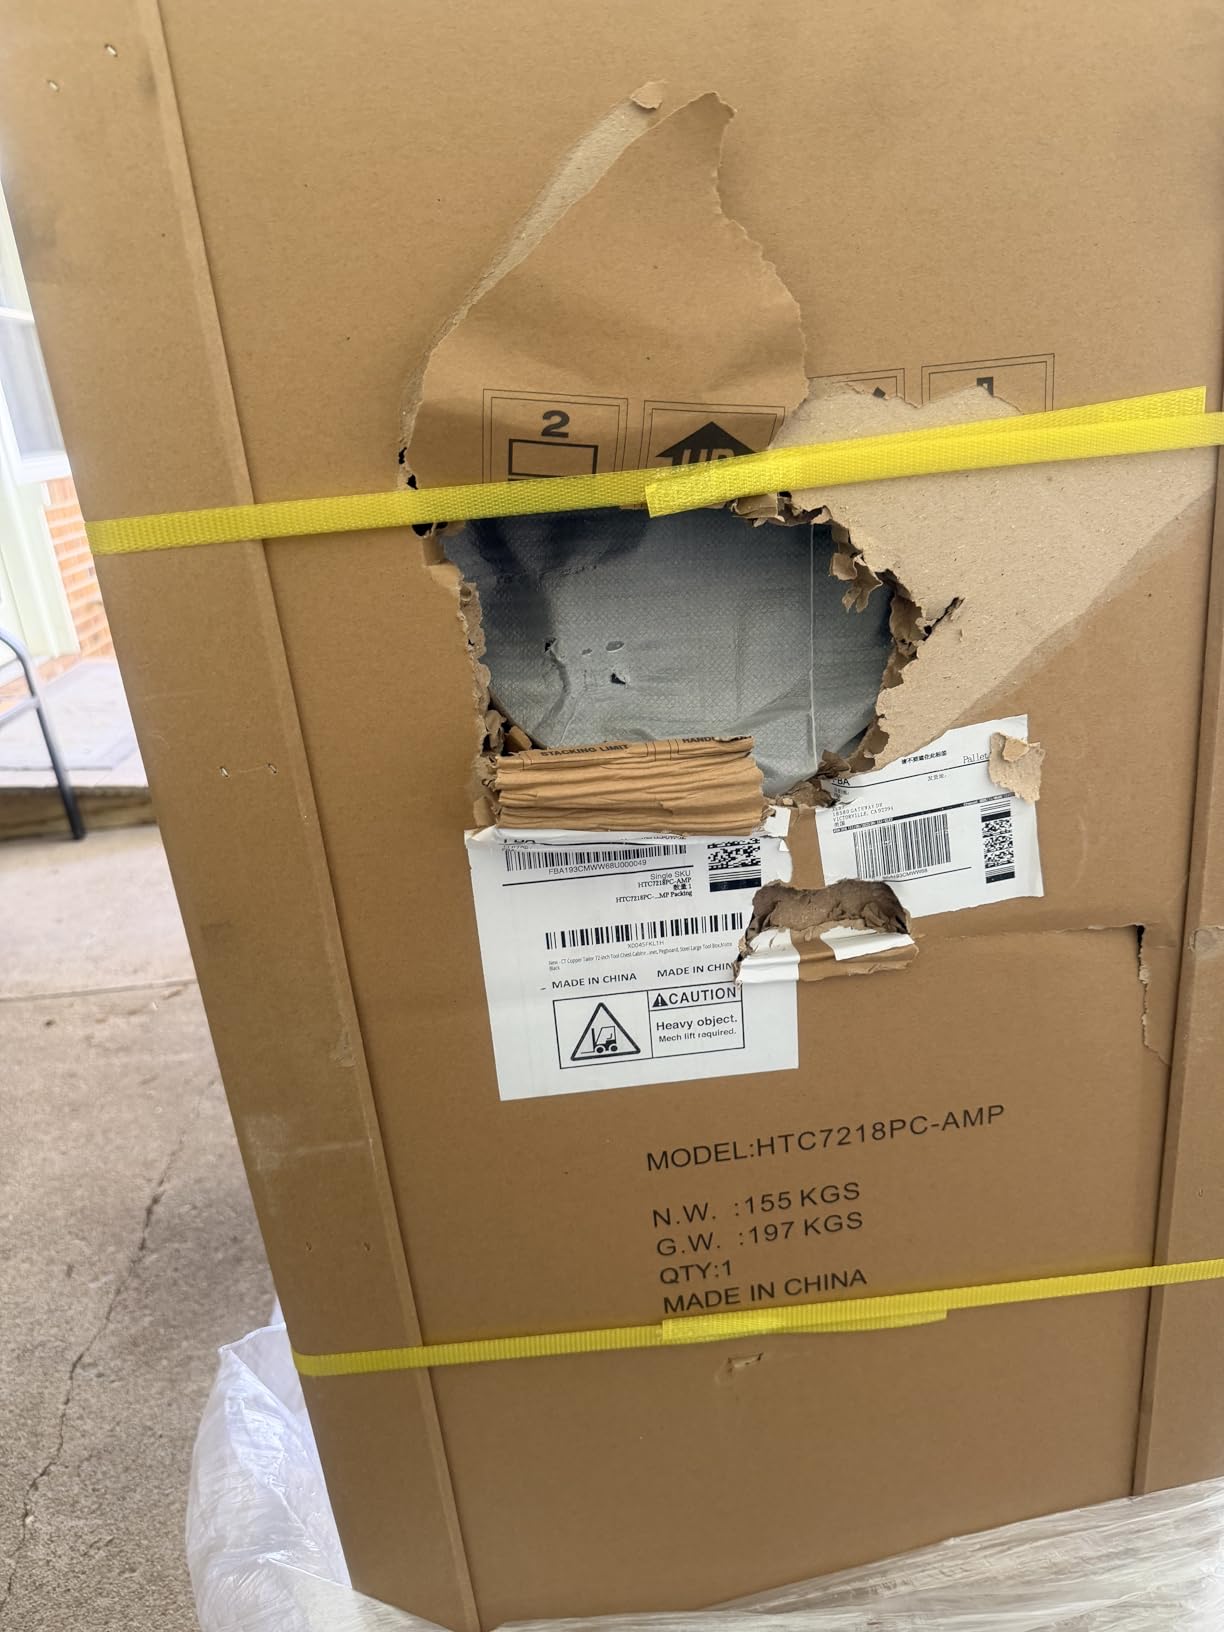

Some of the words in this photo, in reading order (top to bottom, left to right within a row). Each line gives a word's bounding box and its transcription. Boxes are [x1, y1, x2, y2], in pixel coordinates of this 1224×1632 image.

[540, 409, 571, 439] 2
[540, 747, 597, 757] STACKING
[599, 744, 629, 752] LIMIT
[637, 876, 692, 888] HTC7218PC-AMP
[650, 872, 673, 881] Single
[674, 869, 691, 878] SKU
[670, 890, 693, 898] Packing
[656, 966, 690, 978] MADE
[692, 965, 704, 974] IN
[707, 962, 734, 972] CHIN
[551, 977, 585, 989] MADE
[588, 976, 600, 985] IN
[602, 972, 638, 984] CHINA
[668, 986, 737, 1005] CAUTION
[656, 1020, 693, 1031] Heavy
[696, 1013, 738, 1027] object.
[658, 1034, 682, 1043] Mech
[684, 1032, 696, 1040] lift
[697, 1028, 737, 1039] required.
[646, 1103, 1005, 1172] MODEL:HTC7218PC-AMP
[652, 1201, 717, 1228] N.W.
[800, 1181, 862, 1208] KGS
[656, 1231, 721, 1257] G.W.
[802, 1210, 864, 1237] KGS
[659, 1259, 733, 1285] QTY:1
[663, 1286, 740, 1314] MADE
[750, 1281, 776, 1302] IN
[784, 1268, 868, 1297] CHINA
